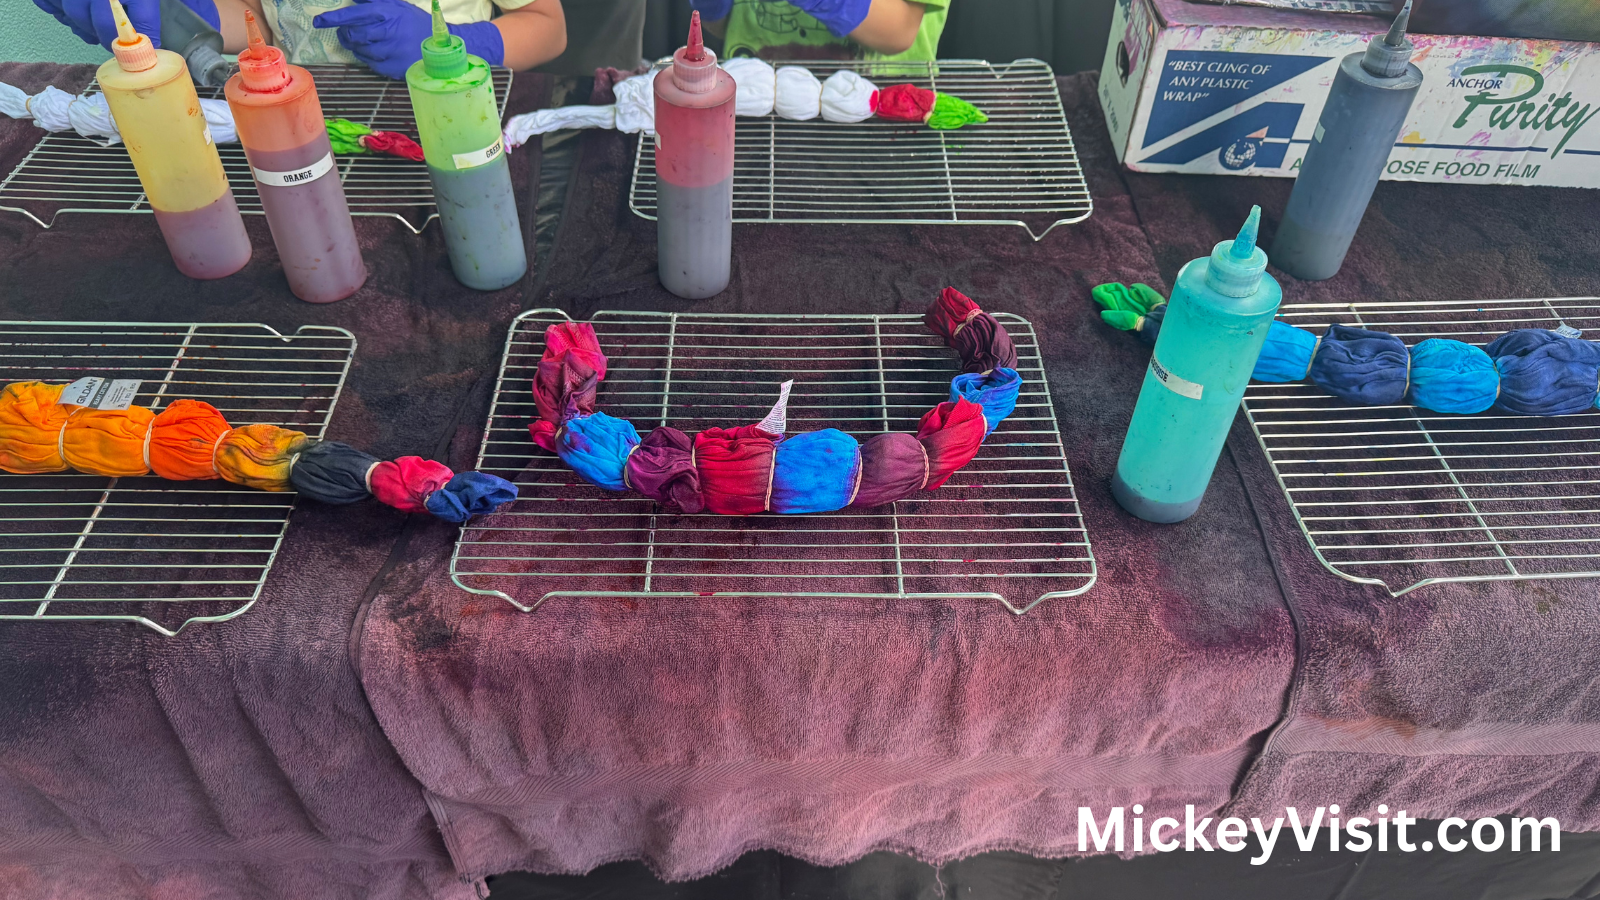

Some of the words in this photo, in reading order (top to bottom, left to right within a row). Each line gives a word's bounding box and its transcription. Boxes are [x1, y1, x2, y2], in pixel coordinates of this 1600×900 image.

[1207, 61, 1249, 75] CLING
[1251, 64, 1272, 75] OF
[1169, 76, 1200, 87] ANY
[1200, 77, 1254, 90] PLASTIC
[1446, 78, 1503, 90] ANCHOR
[1452, 64, 1600, 160] Purity
[283, 169, 313, 183] ORANGE
[1385, 160, 1430, 174] OSE
[1431, 161, 1490, 178] FOOD
[1493, 163, 1542, 179] FILM
[76, 378, 98, 404] GILDAN
